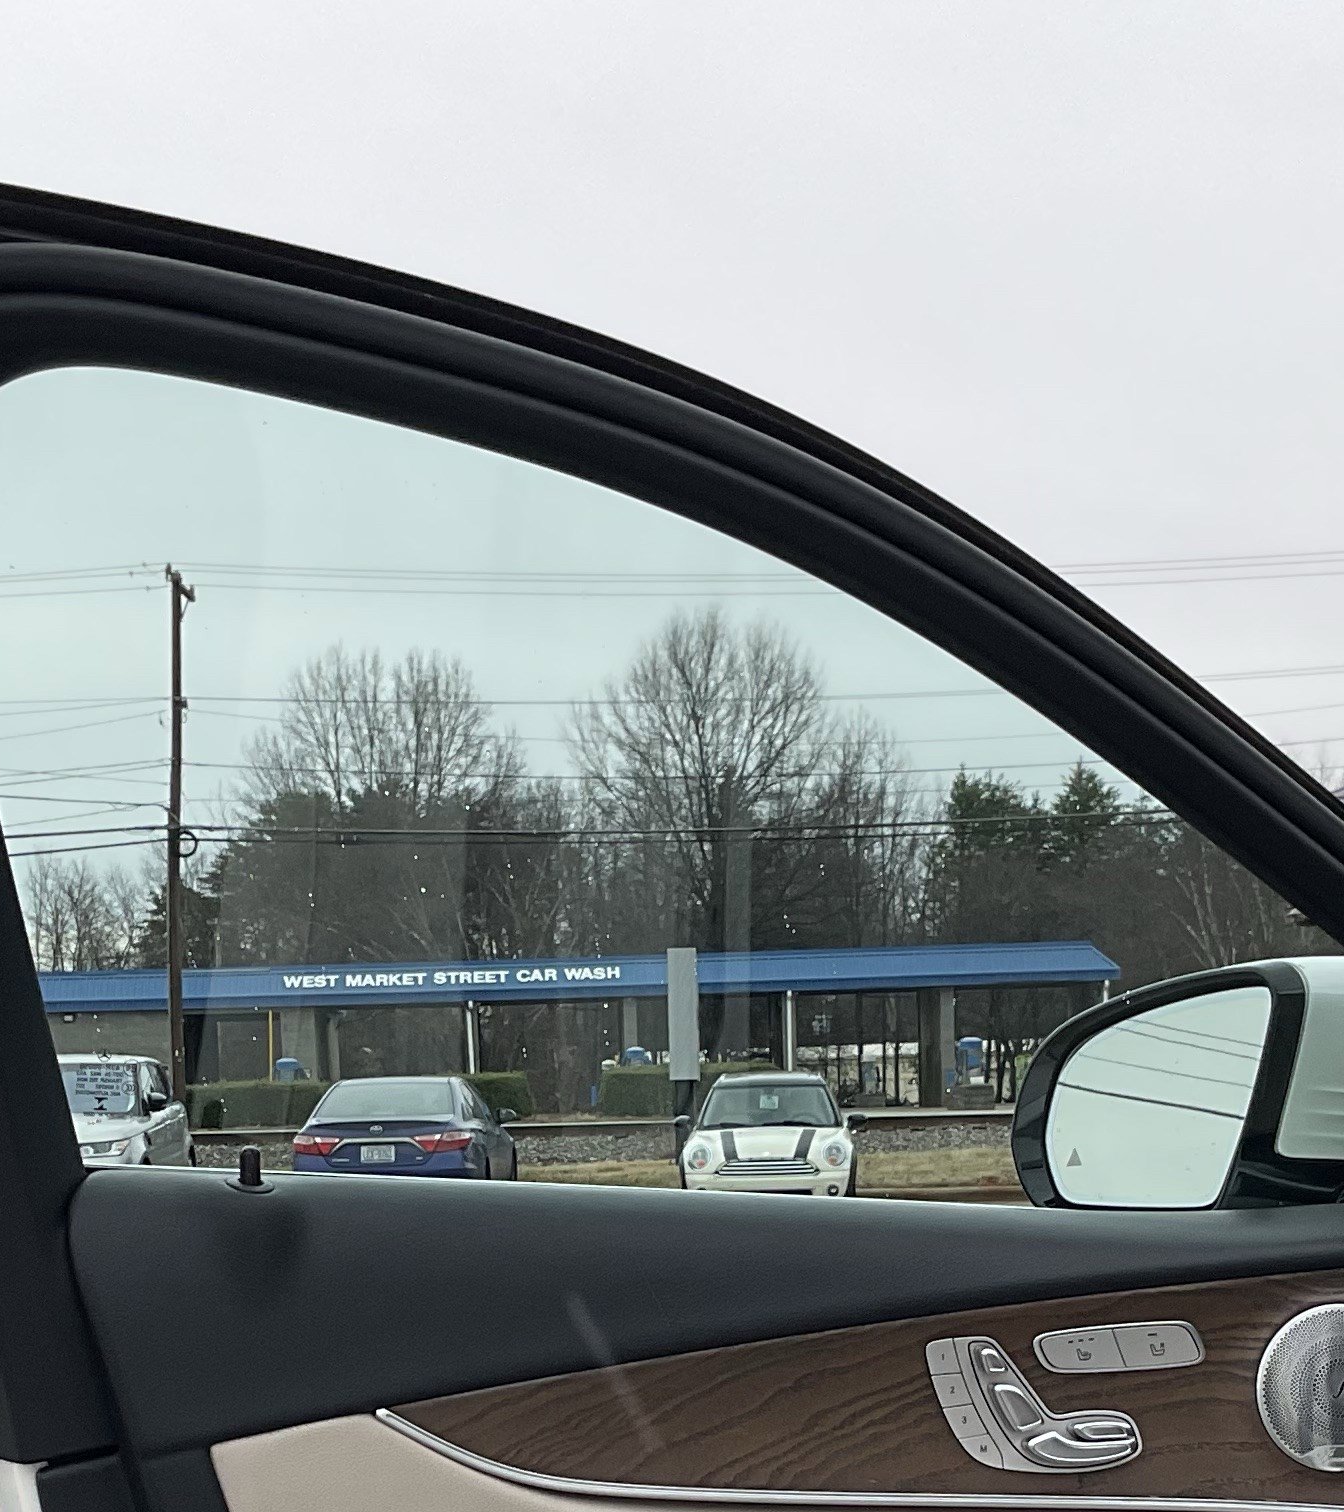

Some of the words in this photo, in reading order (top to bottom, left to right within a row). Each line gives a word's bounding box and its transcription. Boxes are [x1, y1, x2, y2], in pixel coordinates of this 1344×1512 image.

[283, 973, 339, 989] WEST
[345, 972, 427, 988] MARKET
[433, 969, 509, 985] STREET
[516, 968, 557, 982] CAR
[563, 966, 621, 981] WASH
[950, 1386, 955, 1394] 2
[961, 1416, 967, 1424] 3
